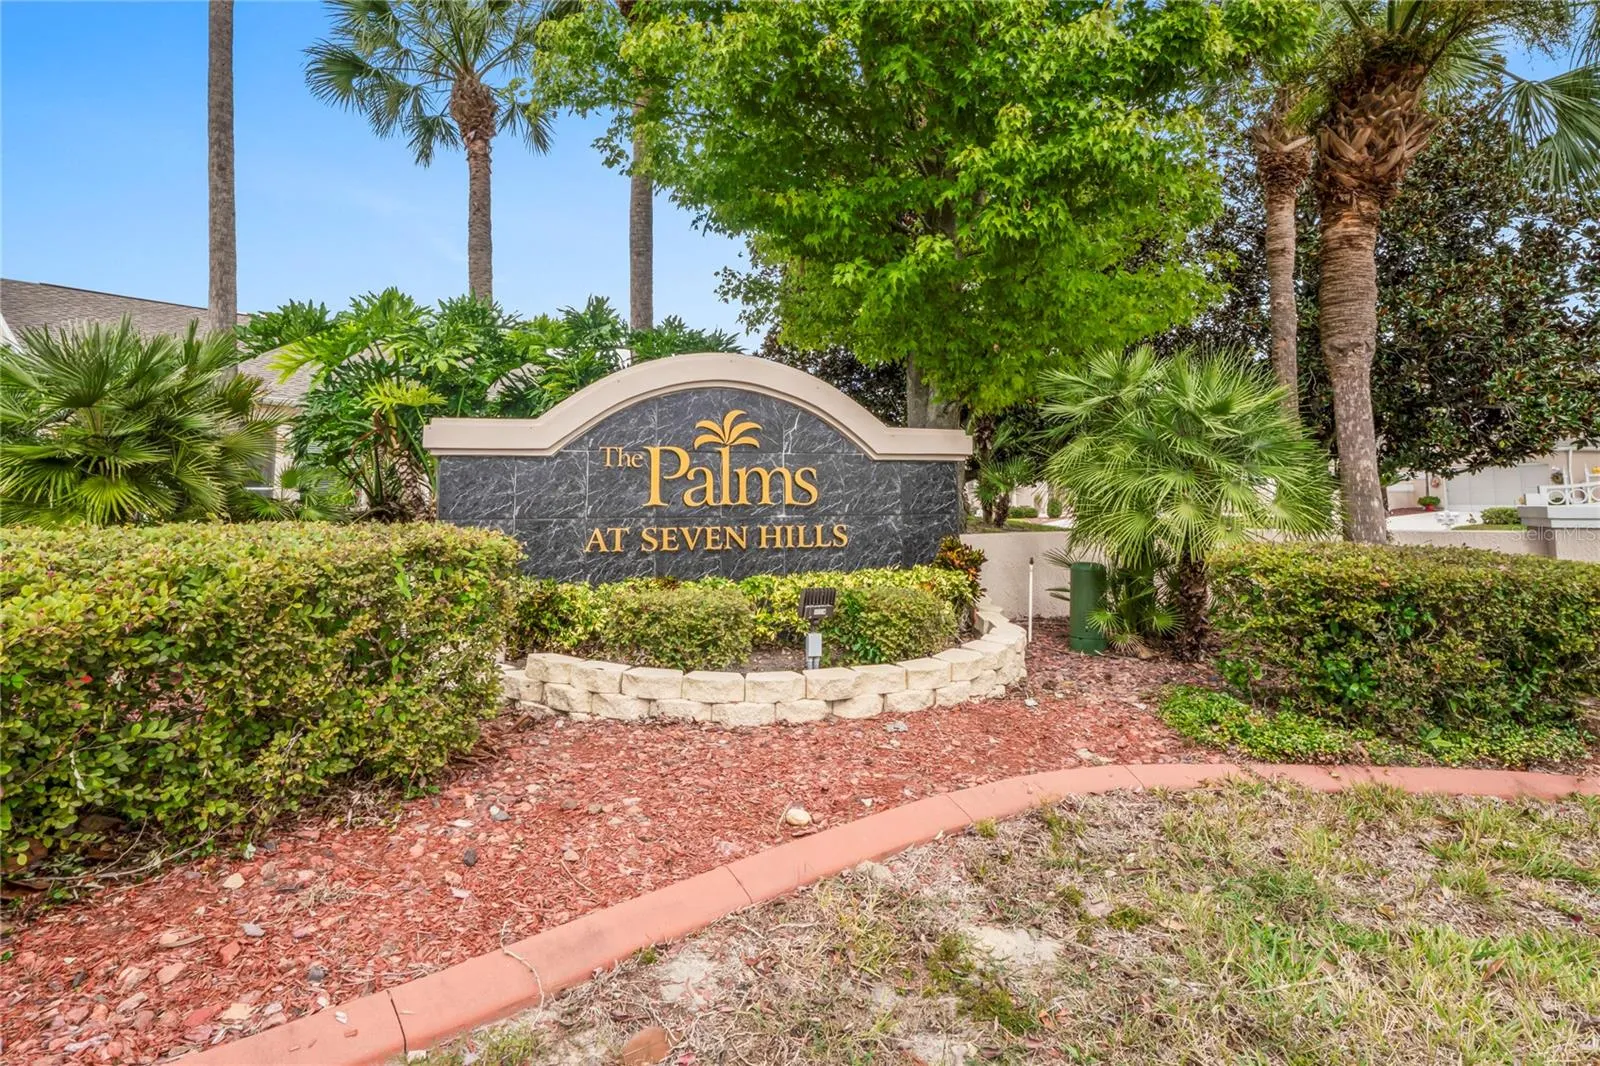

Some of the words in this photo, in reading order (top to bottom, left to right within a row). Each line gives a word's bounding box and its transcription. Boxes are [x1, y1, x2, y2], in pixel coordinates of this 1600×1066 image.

[599, 446, 644, 469] The
[641, 445, 819, 508] Palms
[584, 527, 630, 553] AT
[640, 525, 747, 552] SEVEN
[757, 523, 850, 550] HILLS
